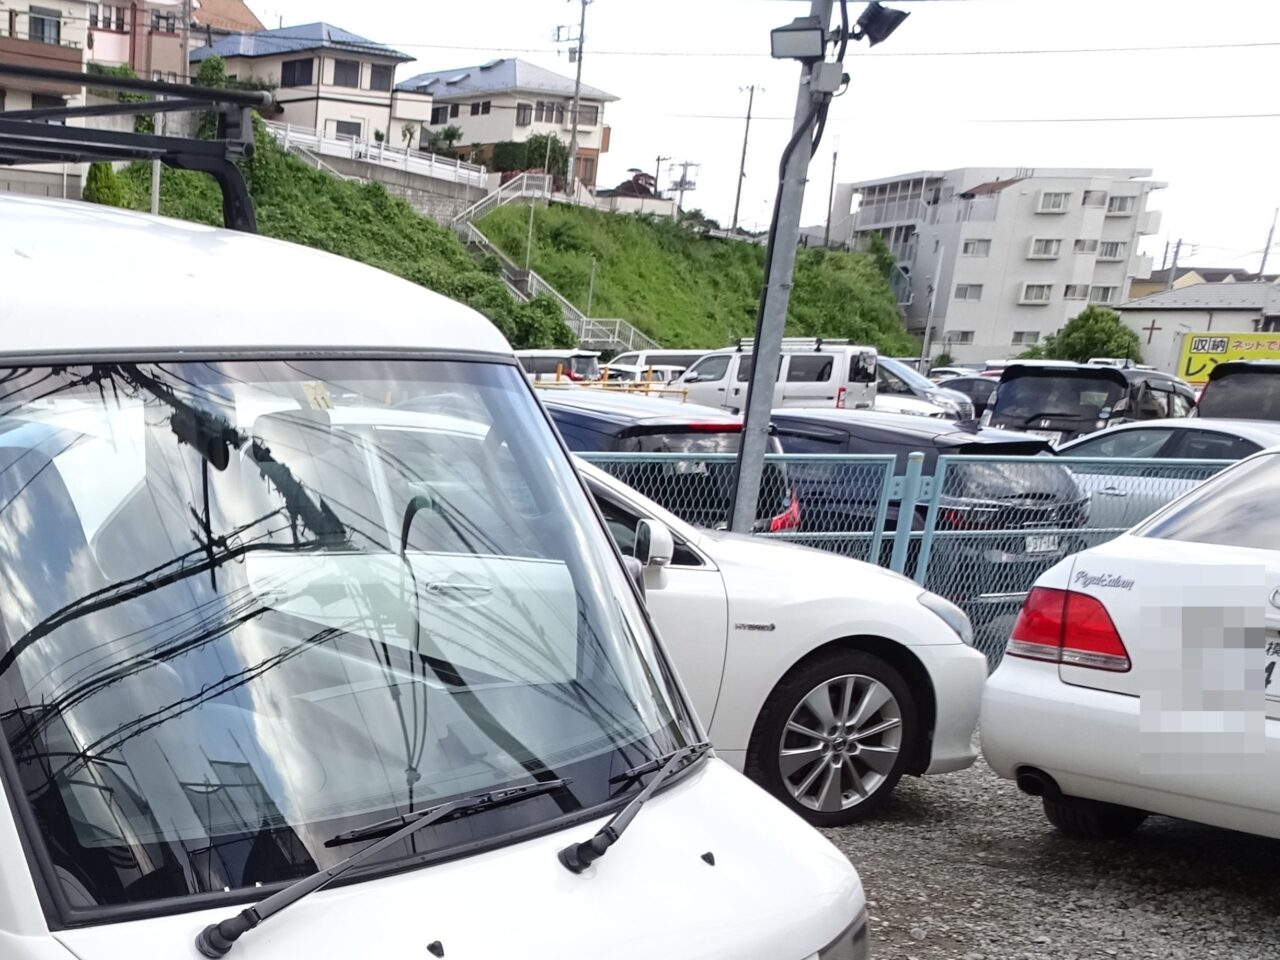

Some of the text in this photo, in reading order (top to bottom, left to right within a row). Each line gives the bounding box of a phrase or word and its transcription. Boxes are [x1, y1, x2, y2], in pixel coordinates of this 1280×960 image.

[1192, 337, 1280, 353] 収納 ネットで
